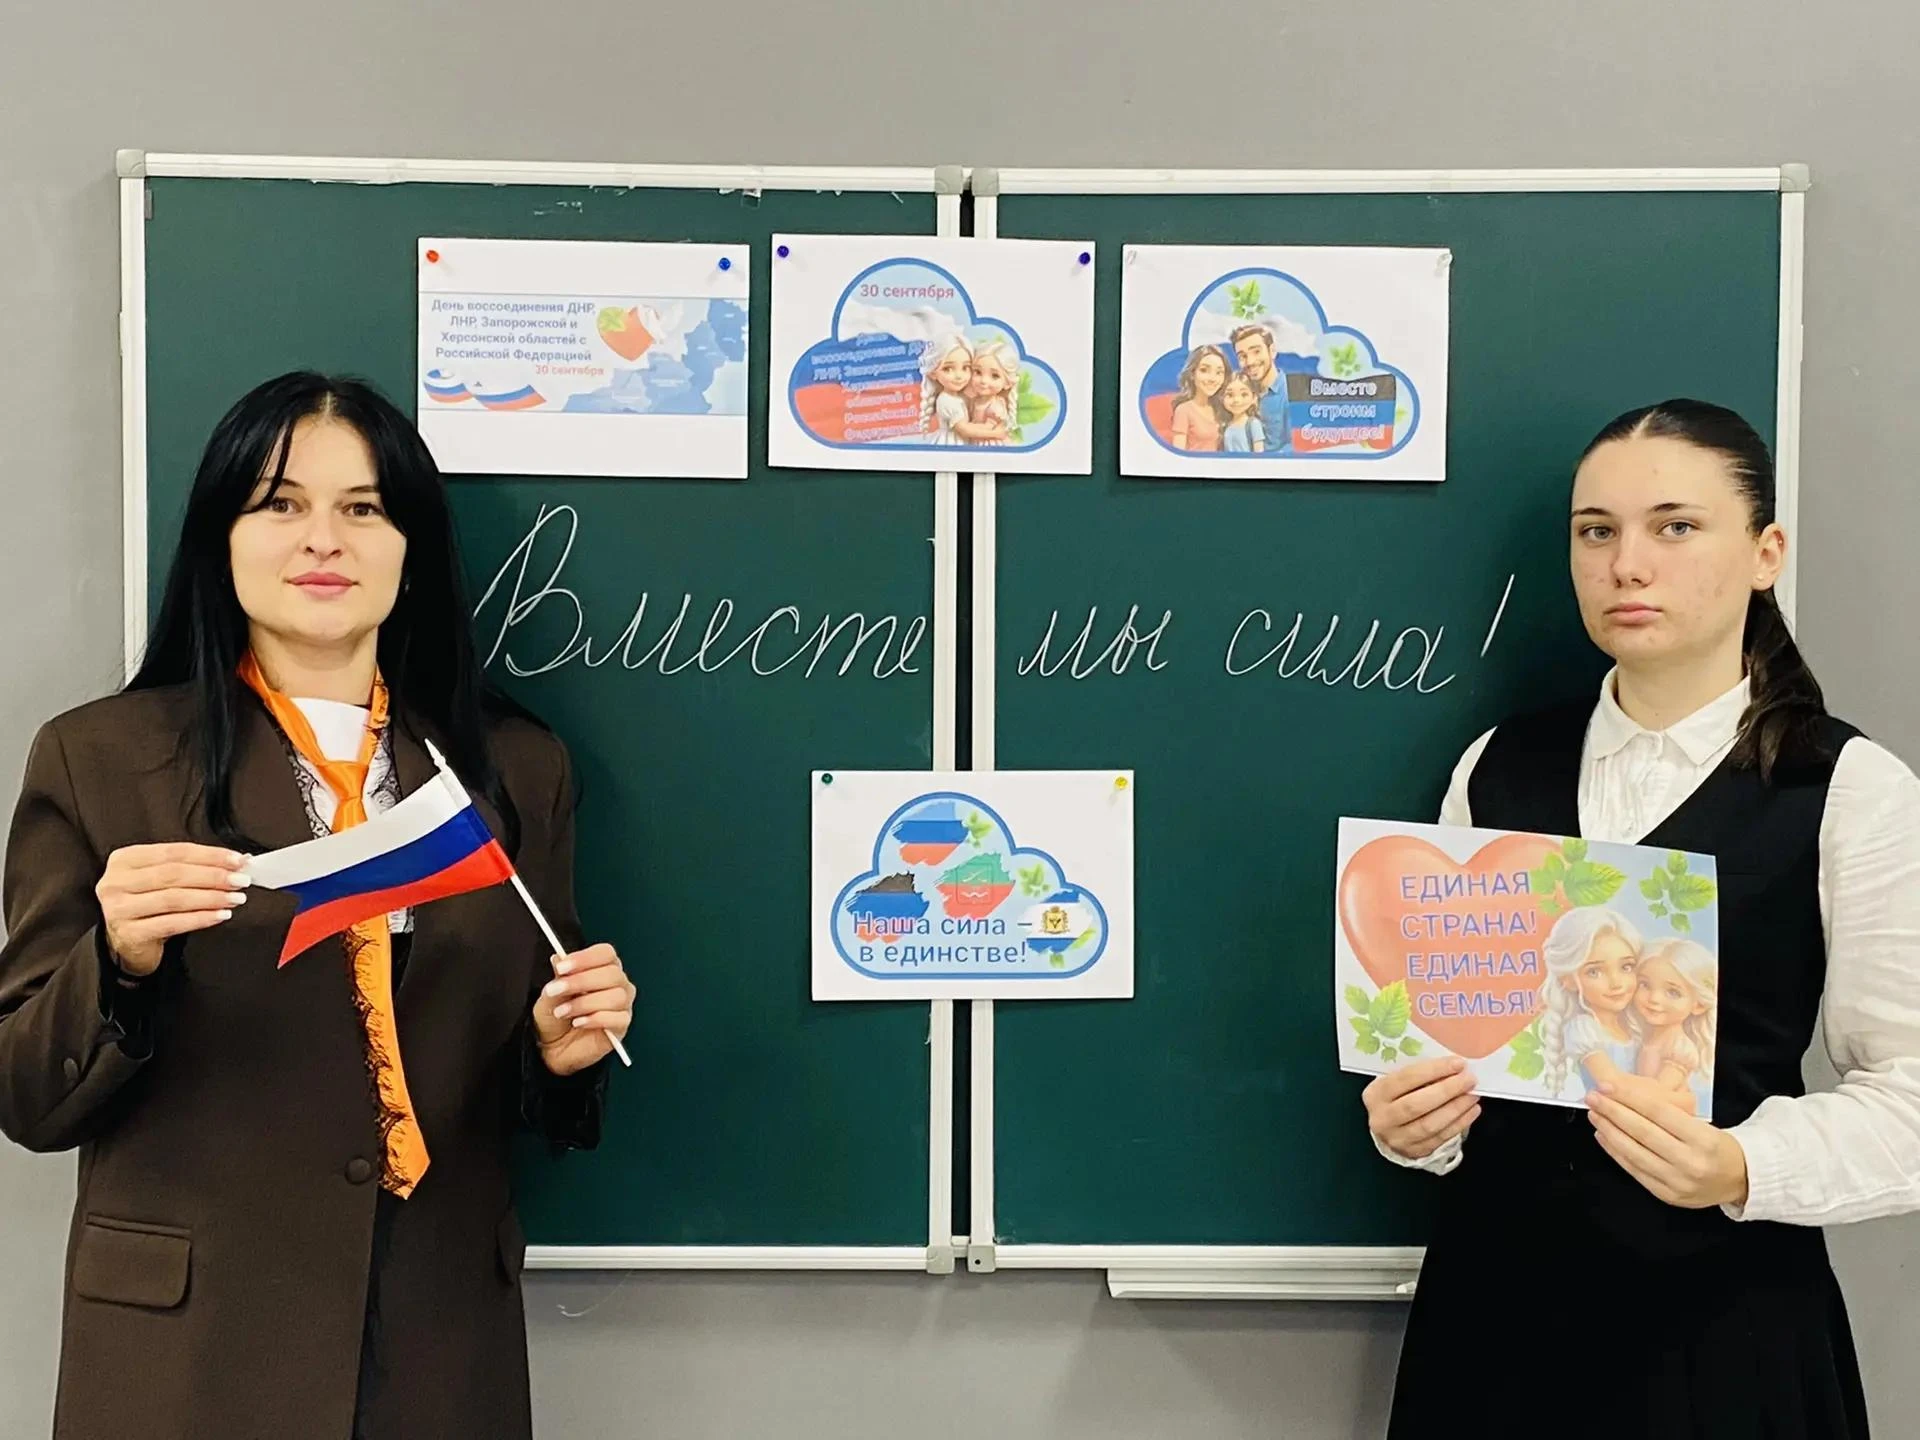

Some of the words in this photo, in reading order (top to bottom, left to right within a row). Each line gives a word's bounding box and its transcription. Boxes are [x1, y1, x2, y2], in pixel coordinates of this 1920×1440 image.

[860, 284, 879, 298] 30
[883, 284, 954, 301] сентября
[431, 299, 464, 312] День
[467, 301, 564, 315] воссоединения
[567, 302, 596, 315] ДНР,
[450, 316, 478, 329] ЛНР,
[481, 316, 567, 331] Запорожской
[569, 319, 578, 329] и
[441, 331, 515, 345] Херсонской
[518, 331, 577, 345] областей
[579, 336, 587, 345] с
[435, 347, 510, 360] Российской
[513, 349, 592, 363] Федерацией
[551, 365, 604, 377] сентября
[1310, 379, 1377, 396] Вместе
[1309, 404, 1377, 422] строим
[473, 503, 927, 679] Вместе
[1017, 604, 1172, 680] мы
[1401, 871, 1531, 904] ЕДИНАЯ
[853, 911, 930, 935] Наша
[941, 918, 1006, 935] сила
[1402, 911, 1537, 939] СТРАНА!
[860, 945, 874, 962] в
[884, 941, 1026, 967] единстве!
[1408, 951, 1538, 983] ЕДИНАЯ
[1418, 991, 1535, 1018] СЕМЬЯ!
